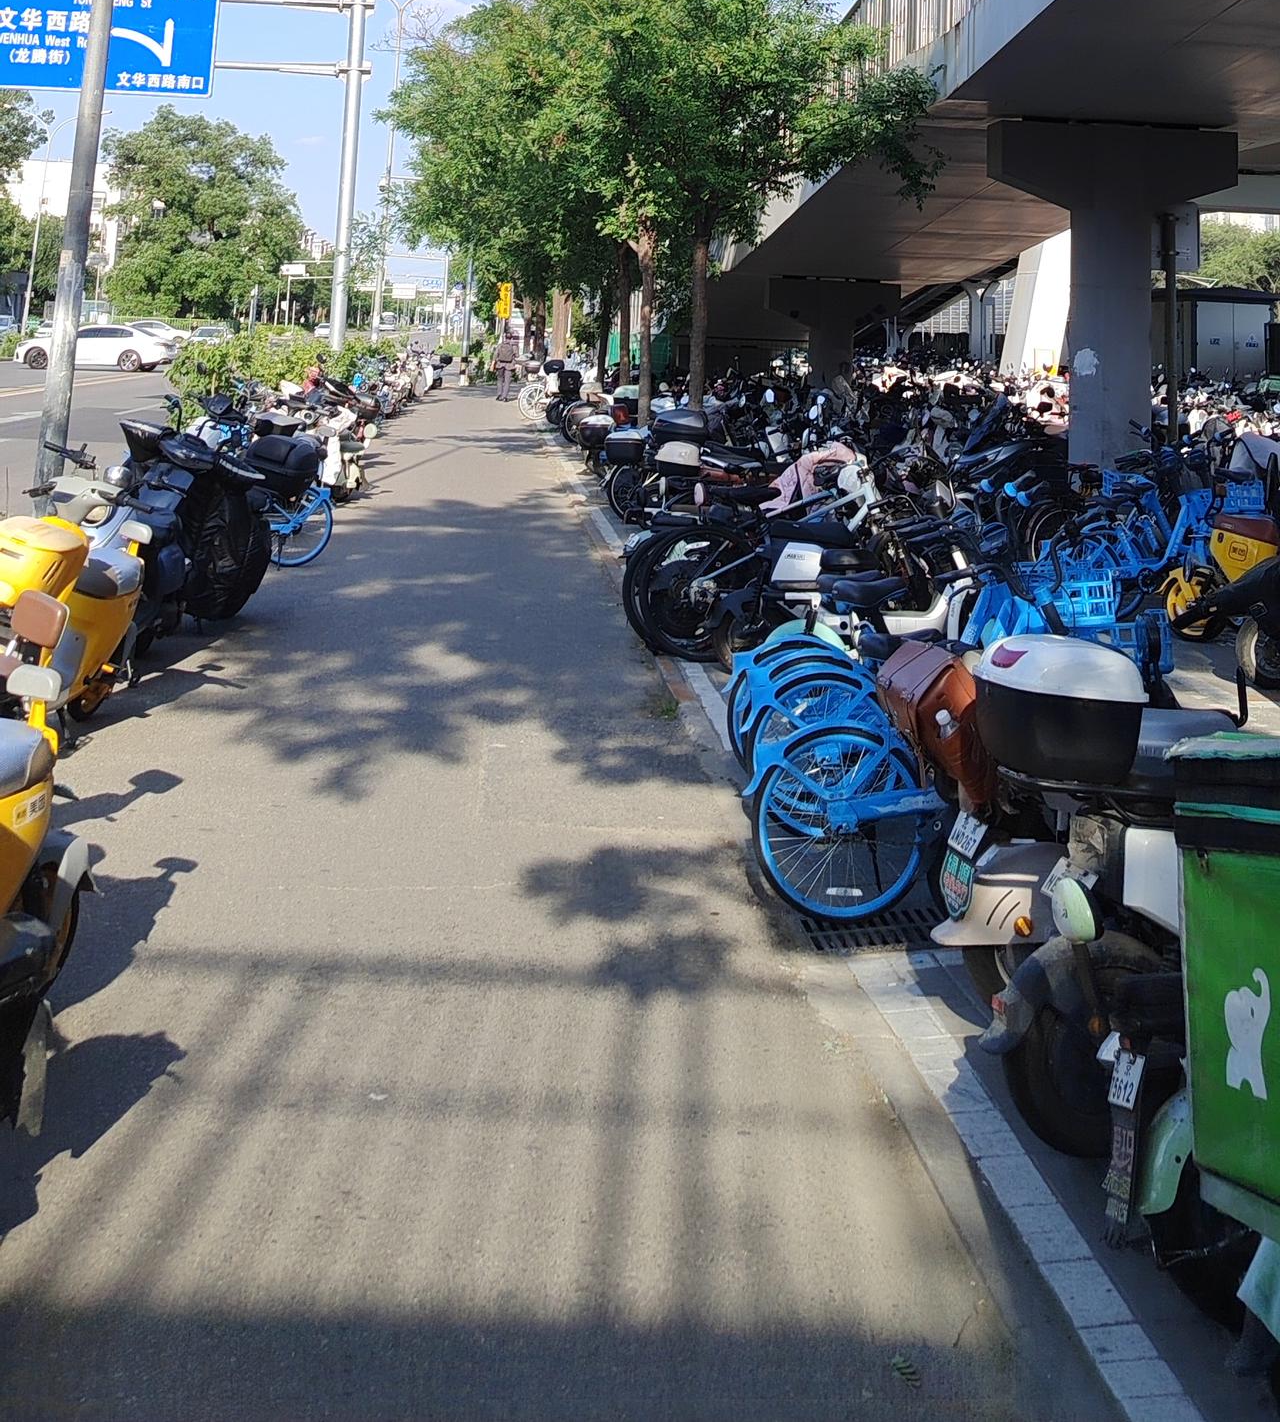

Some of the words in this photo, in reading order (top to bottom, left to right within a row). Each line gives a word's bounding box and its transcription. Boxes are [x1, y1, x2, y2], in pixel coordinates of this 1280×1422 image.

[0, 7, 91, 33] 文华西路
[45, 35, 71, 48] West
[116, 71, 205, 90] 文华西路南口
